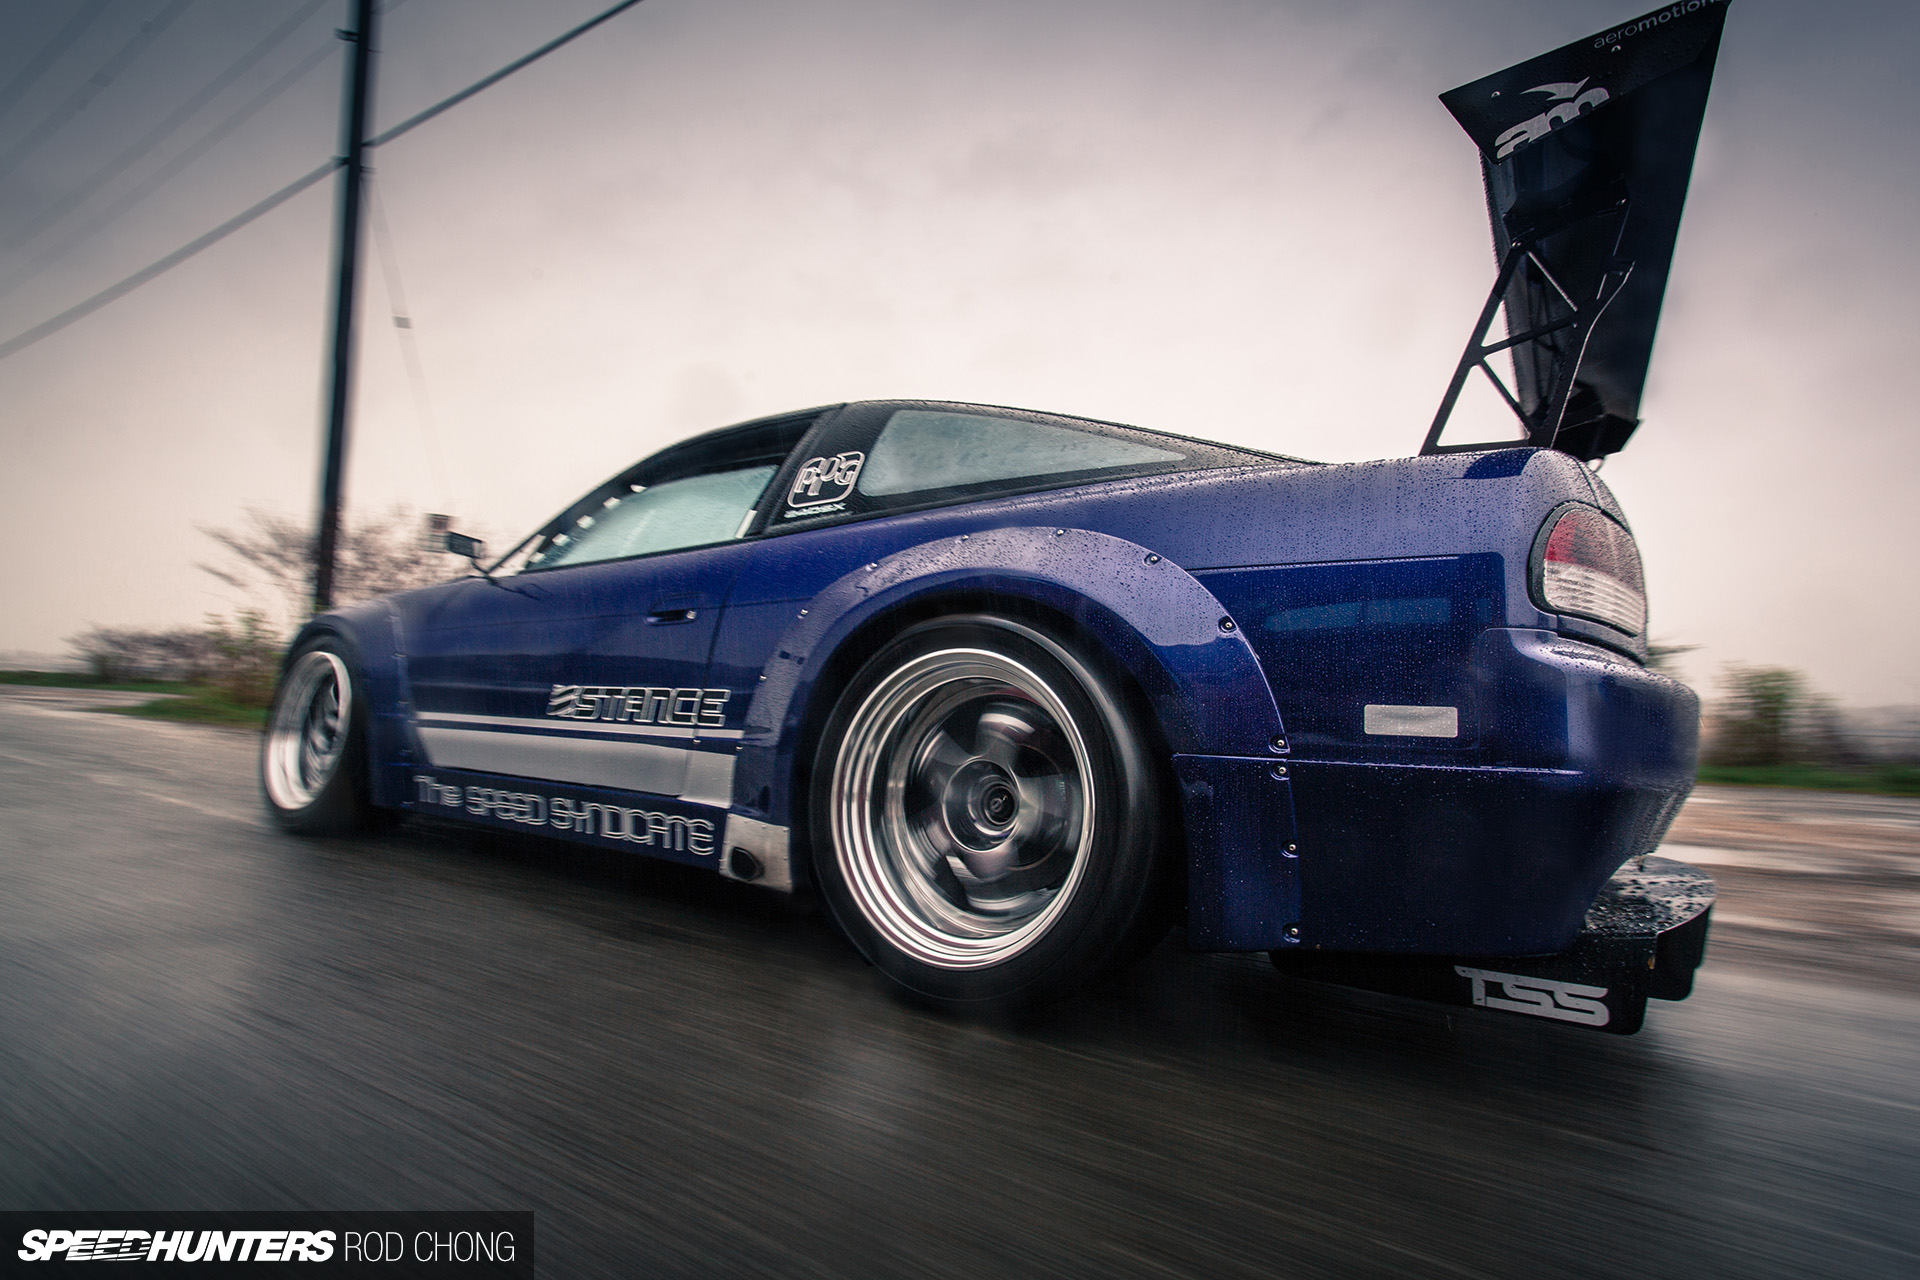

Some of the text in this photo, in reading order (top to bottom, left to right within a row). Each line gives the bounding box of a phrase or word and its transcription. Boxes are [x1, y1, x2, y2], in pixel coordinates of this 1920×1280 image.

[573, 686, 732, 727] STANCE
[465, 786, 548, 826] SPEED
[549, 797, 715, 856] SYNDICATE
[1454, 965, 1610, 1026] TSS
